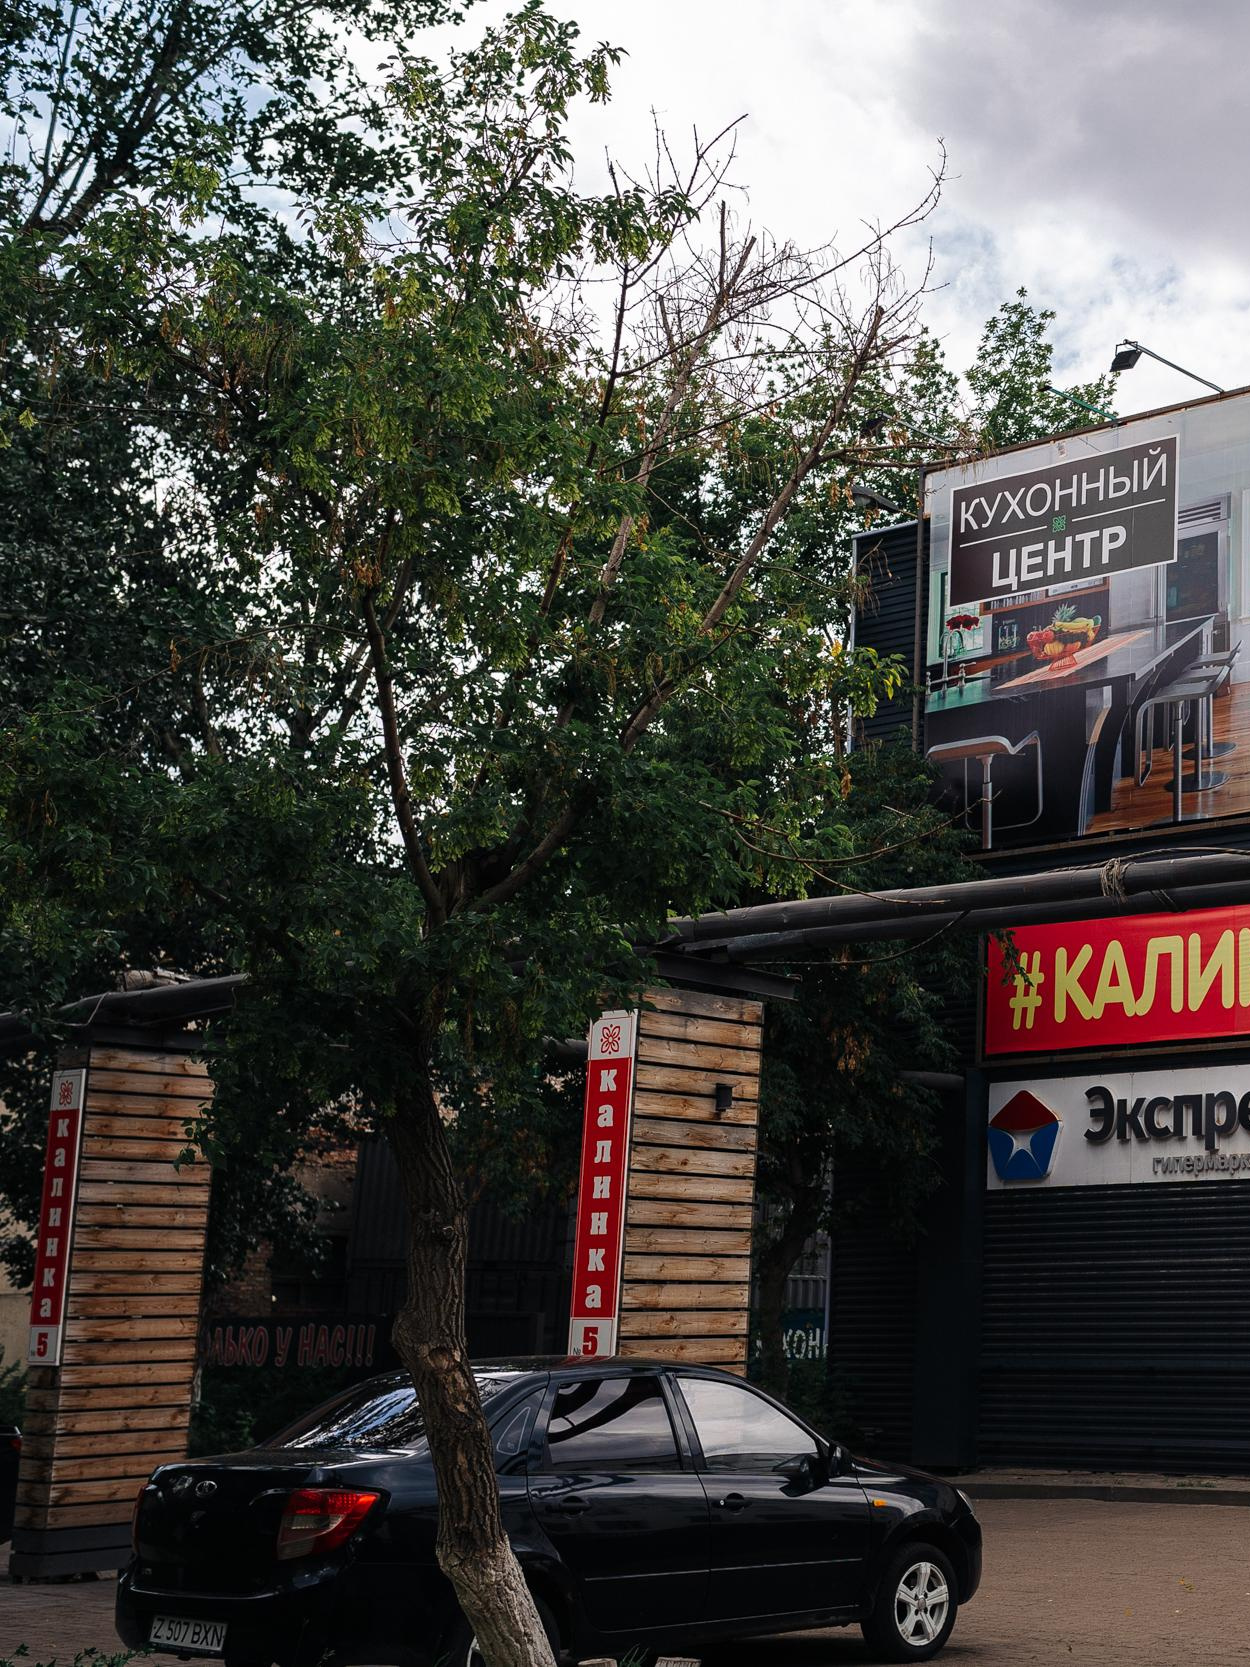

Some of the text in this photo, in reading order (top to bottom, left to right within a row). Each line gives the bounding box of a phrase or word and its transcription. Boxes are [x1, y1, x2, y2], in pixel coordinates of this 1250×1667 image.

[960, 447, 1167, 533] КУХОННЫЙ
[992, 525, 1127, 591] ЦЕНТР
[37, 1333, 48, 1357] 5
[206, 1322, 377, 1369] ЛЬКО У НАС!!!
[582, 1327, 599, 1356] 5
[153, 1618, 224, 1648] Z 507 BXN
